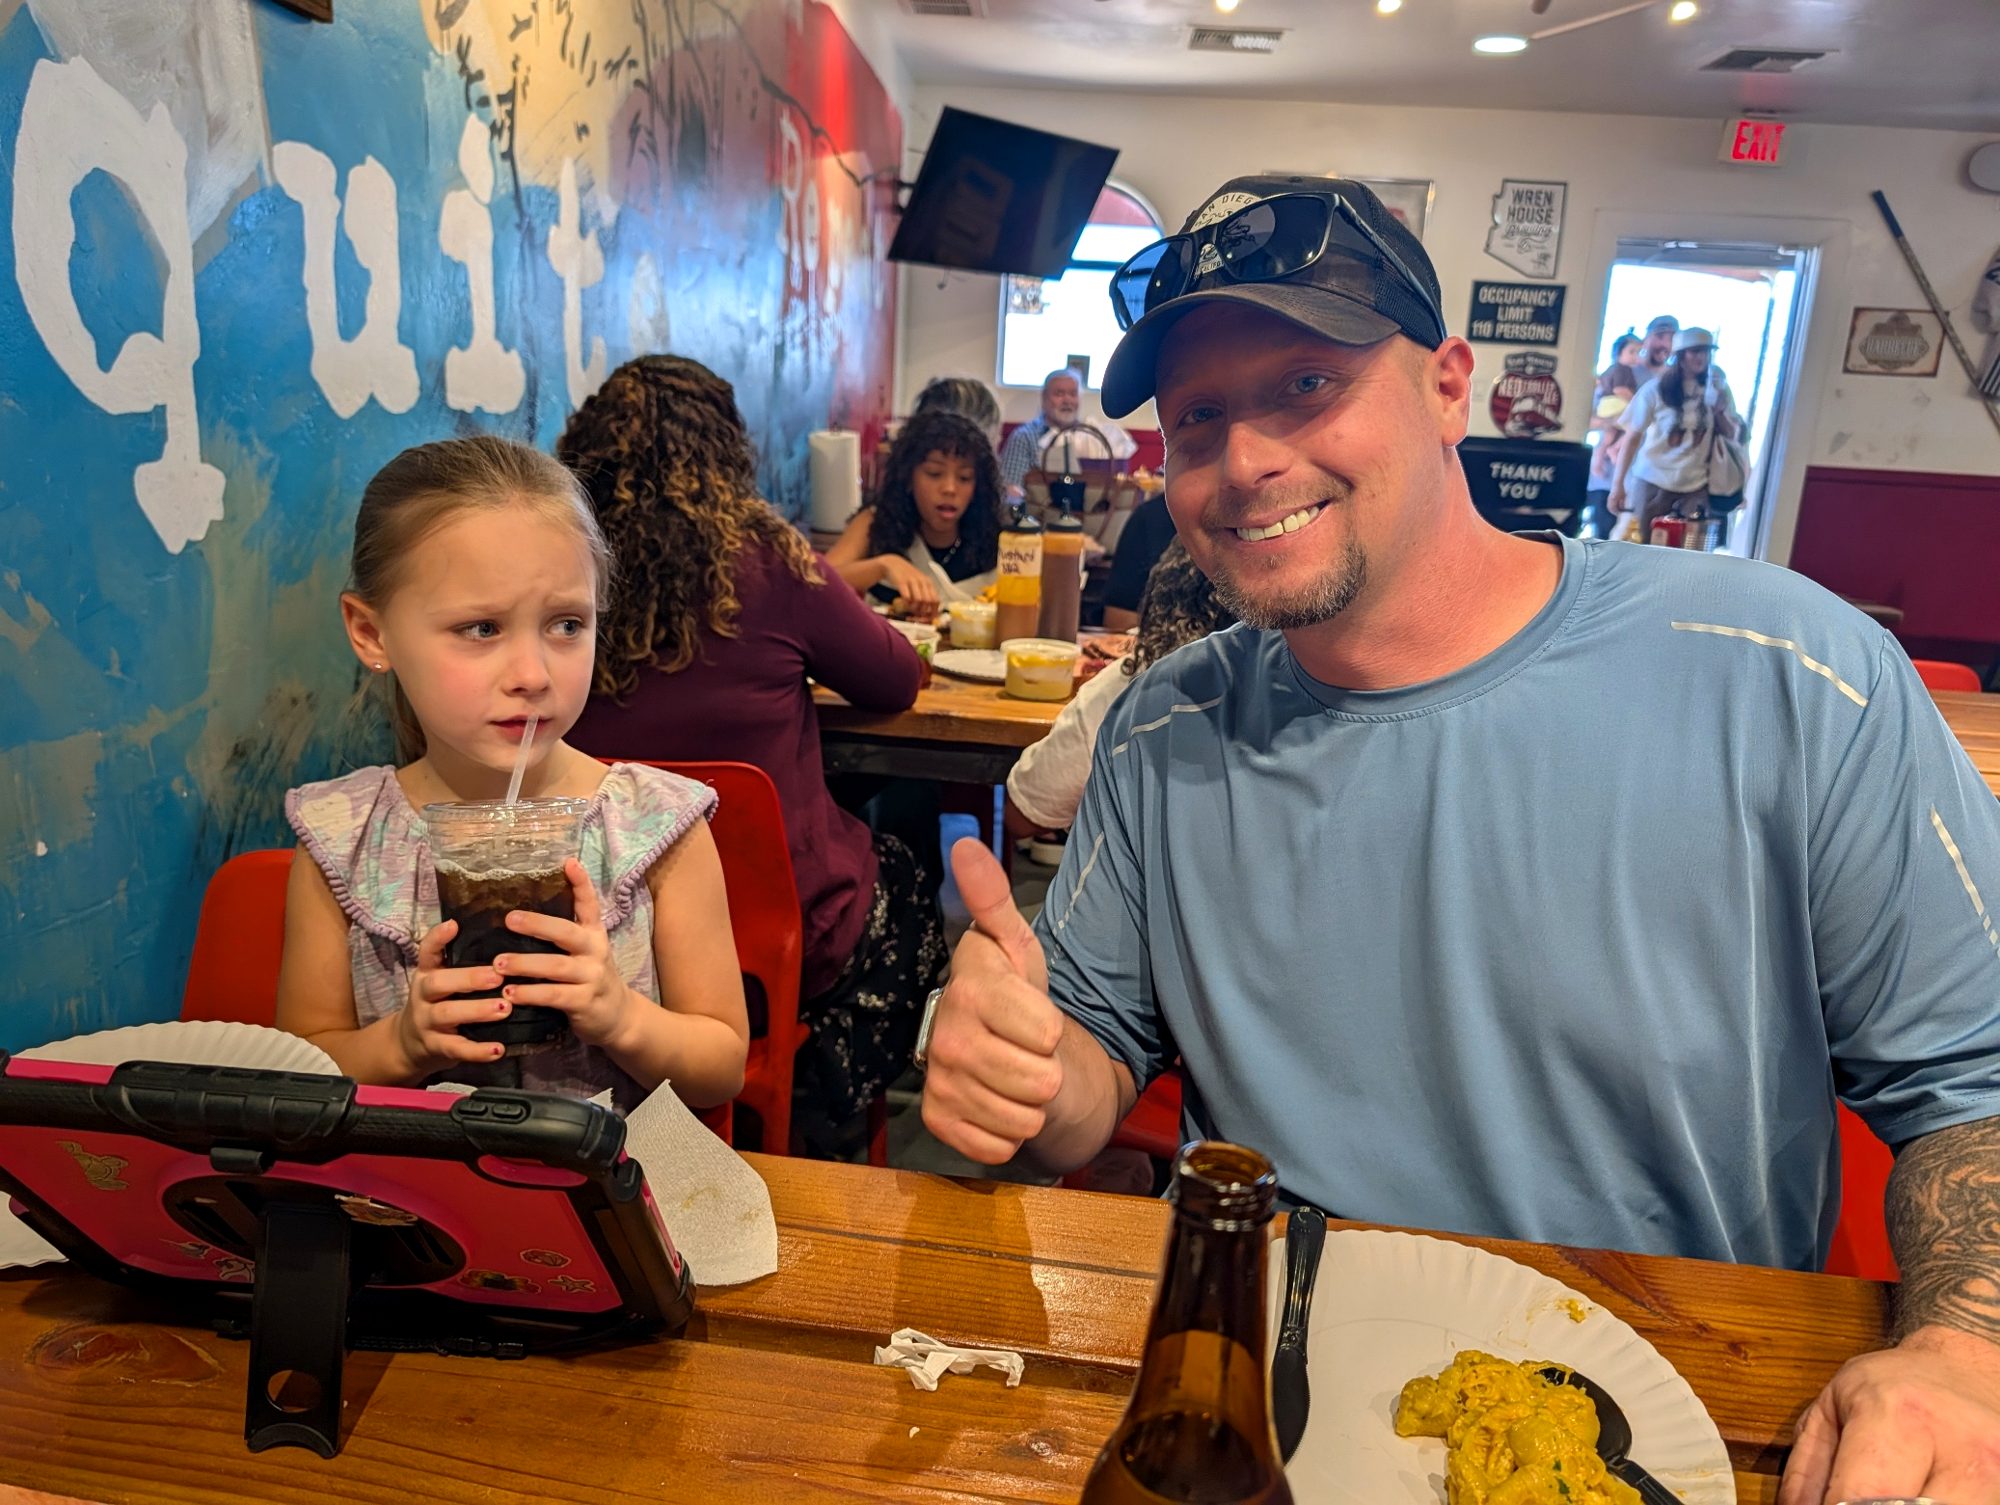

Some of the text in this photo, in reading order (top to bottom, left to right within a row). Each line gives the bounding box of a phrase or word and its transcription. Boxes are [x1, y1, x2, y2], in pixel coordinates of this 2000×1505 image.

[1732, 120, 1785, 162] EXIT
[1222, 194, 1253, 205] DIEG
[1512, 188, 1553, 207] WREN
[1507, 206, 1554, 225] HOUSE
[1479, 286, 1557, 307] OCCUPANCY
[1497, 305, 1534, 322] LIMIT
[1472, 320, 1554, 341] 110 PERSONS
[1498, 376, 1522, 398] RED
[1489, 462, 1555, 482] THANK
[1499, 482, 1540, 499] YOU
